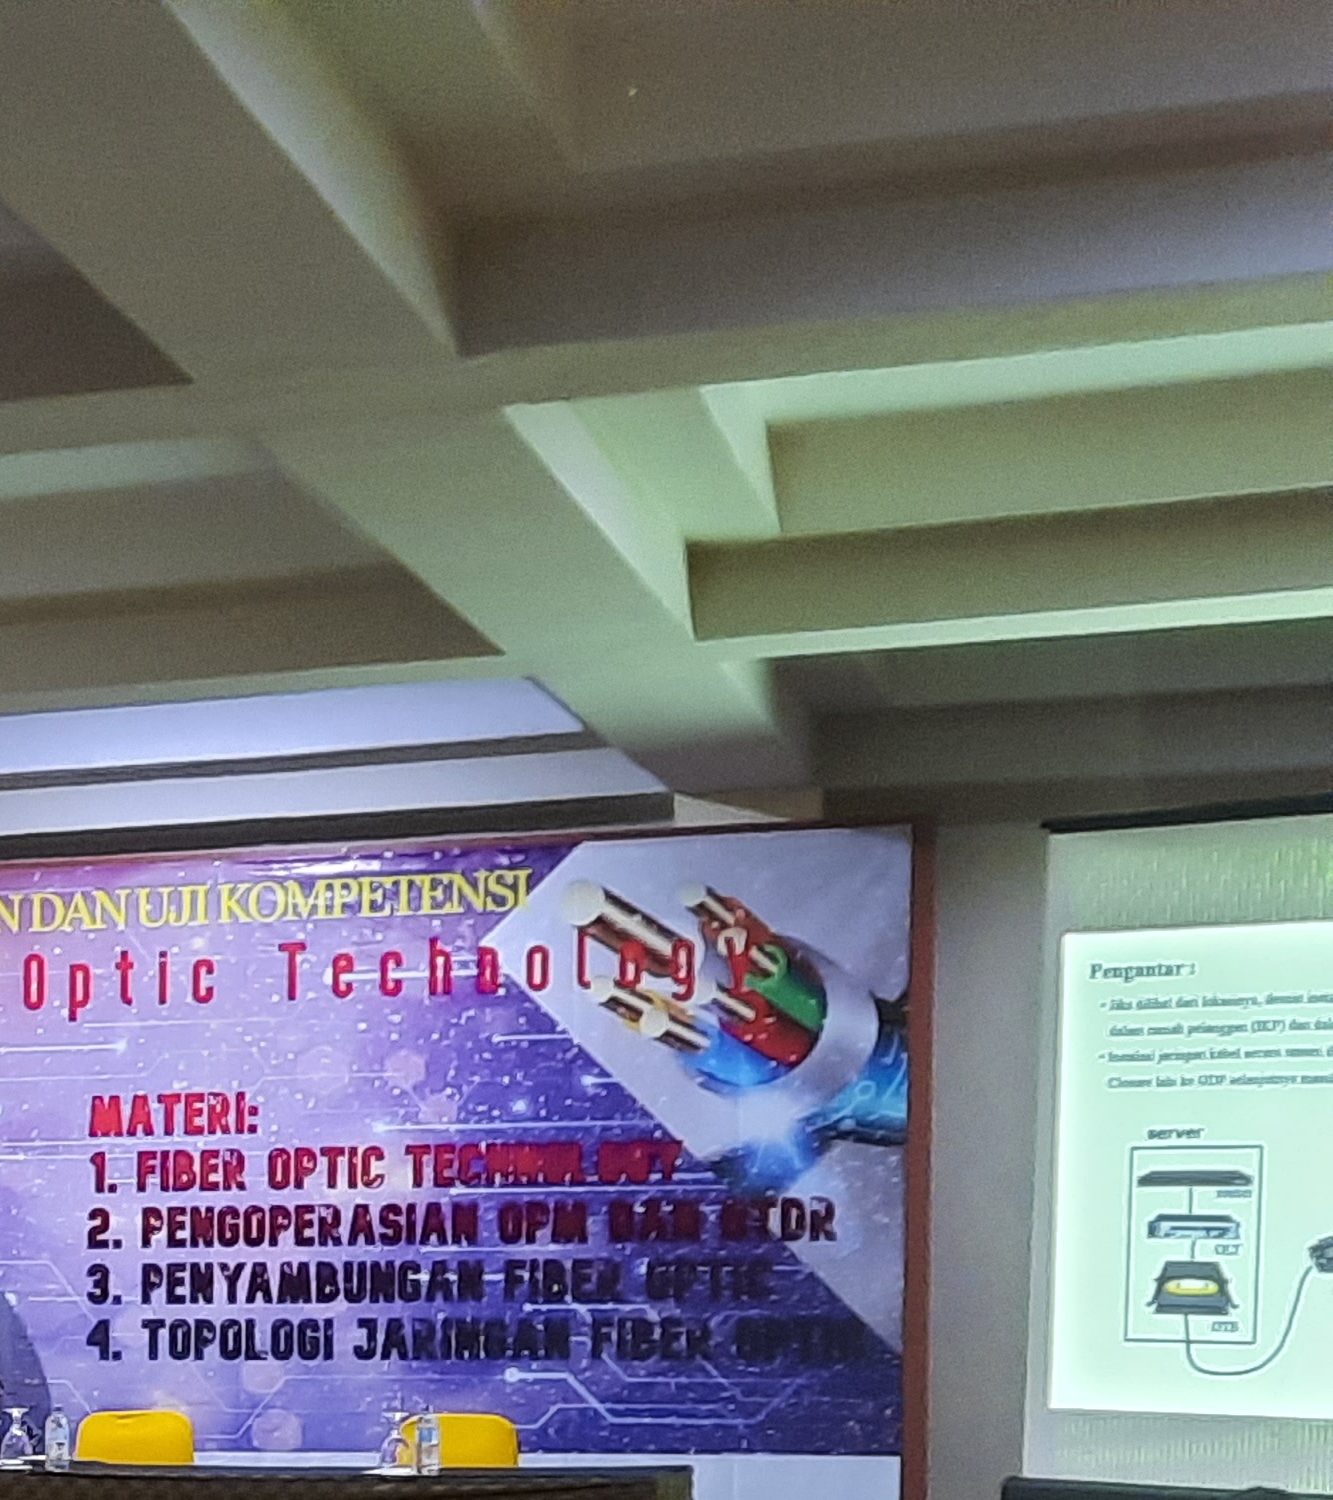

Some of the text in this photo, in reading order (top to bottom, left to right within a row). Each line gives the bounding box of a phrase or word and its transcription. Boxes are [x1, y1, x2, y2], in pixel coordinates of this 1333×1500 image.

[29, 889, 132, 933] DAN
[137, 884, 209, 928] UJI
[219, 868, 533, 924] KOMPETENSI
[23, 951, 215, 1022] Optic
[1089, 962, 1183, 983] Pengantar
[88, 1092, 260, 1137] MATERI:
[90, 1151, 118, 1193] 1.
[136, 1149, 247, 1193] FIBER
[268, 1145, 385, 1191] OPTIC
[86, 1207, 123, 1250] 2.
[140, 1201, 479, 1249] PENGOPERASIAN
[86, 1263, 123, 1306] 3.
[140, 1259, 484, 1306] PENYAMBUNGAN
[86, 1321, 123, 1362] 4.
[141, 1318, 333, 1362] TOPOLOGI
